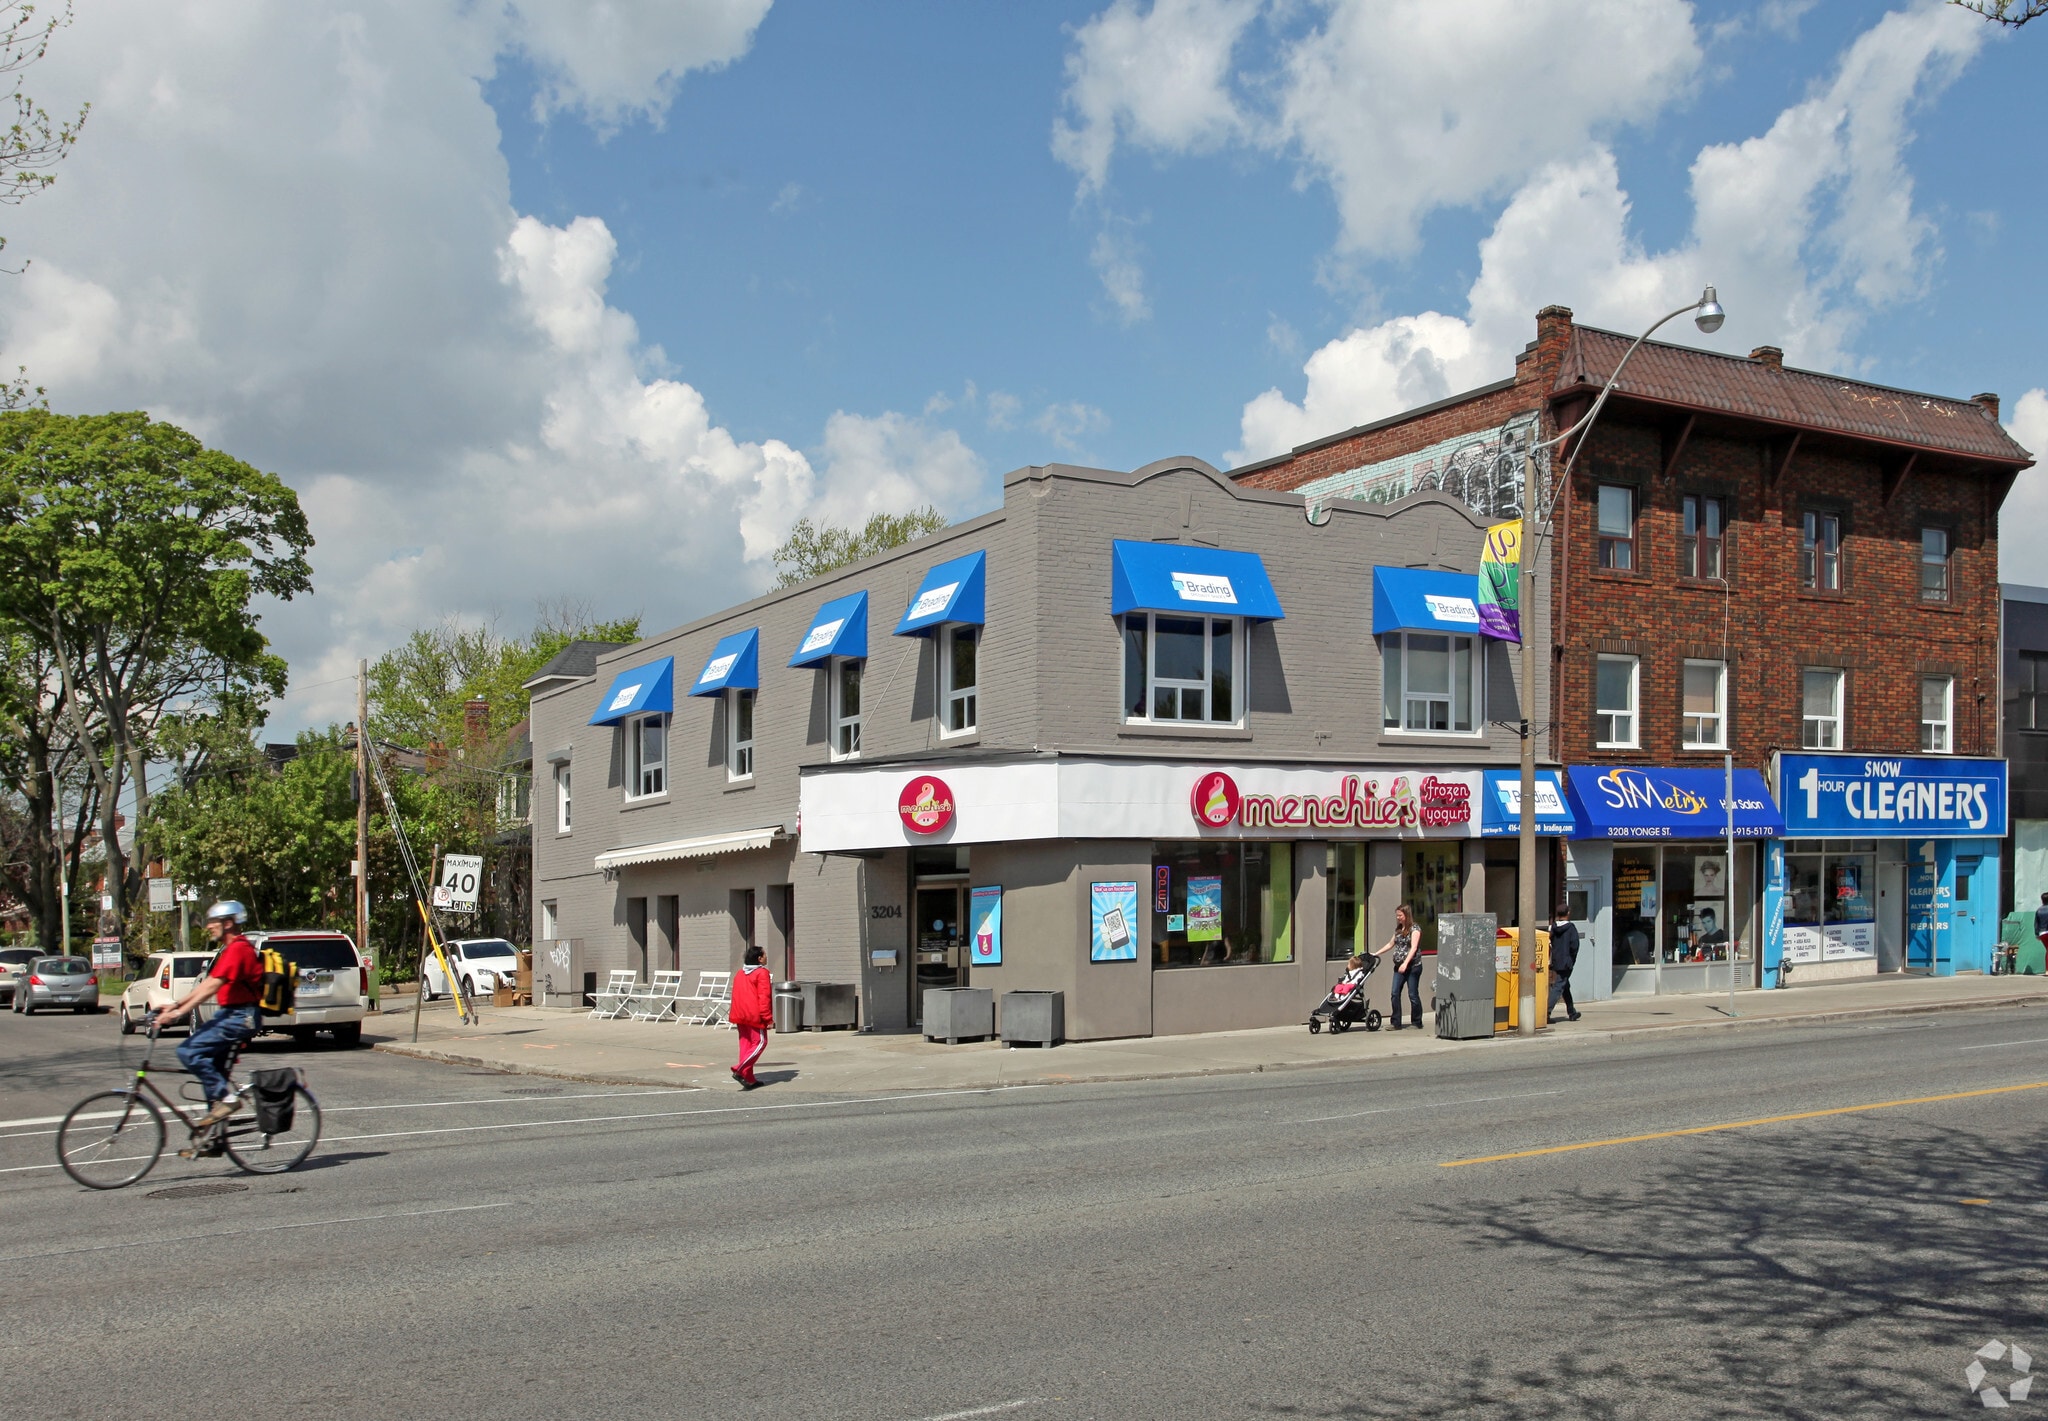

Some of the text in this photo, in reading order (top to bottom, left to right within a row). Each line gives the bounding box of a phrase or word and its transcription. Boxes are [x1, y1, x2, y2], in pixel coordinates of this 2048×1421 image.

[1186, 581, 1231, 597] Brading
[920, 593, 950, 610] Brading
[1437, 602, 1476, 617] Brading
[812, 628, 836, 644] Brading
[1865, 761, 1901, 778] SNOW
[1428, 779, 1468, 798] frozen
[1242, 775, 1419, 828] menchie's
[1512, 790, 1558, 806] Bding
[1719, 799, 1764, 810] Hir Salon
[1799, 768, 1988, 829] 1 HOUR CLEANERS
[901, 799, 952, 814] menchie's
[1427, 803, 1469, 823] yogurt
[1543, 823, 1573, 833] brading.com
[1608, 827, 1672, 836] 3208 YONGE ST.
[1719, 827, 1773, 836] 41-915-5170
[446, 859, 480, 868] MAXIMUM
[1770, 848, 1780, 876] 1
[1919, 841, 1935, 874] 1
[446, 872, 476, 893] 40
[1158, 868, 1167, 910] OPEN
[1909, 887, 1950, 897] CLEANERS
[872, 905, 902, 918] 3204
[1769, 896, 1783, 937] ALTERATION
[1771, 918, 1782, 946] REPAIRS
[1911, 922, 1949, 930] REPARS
